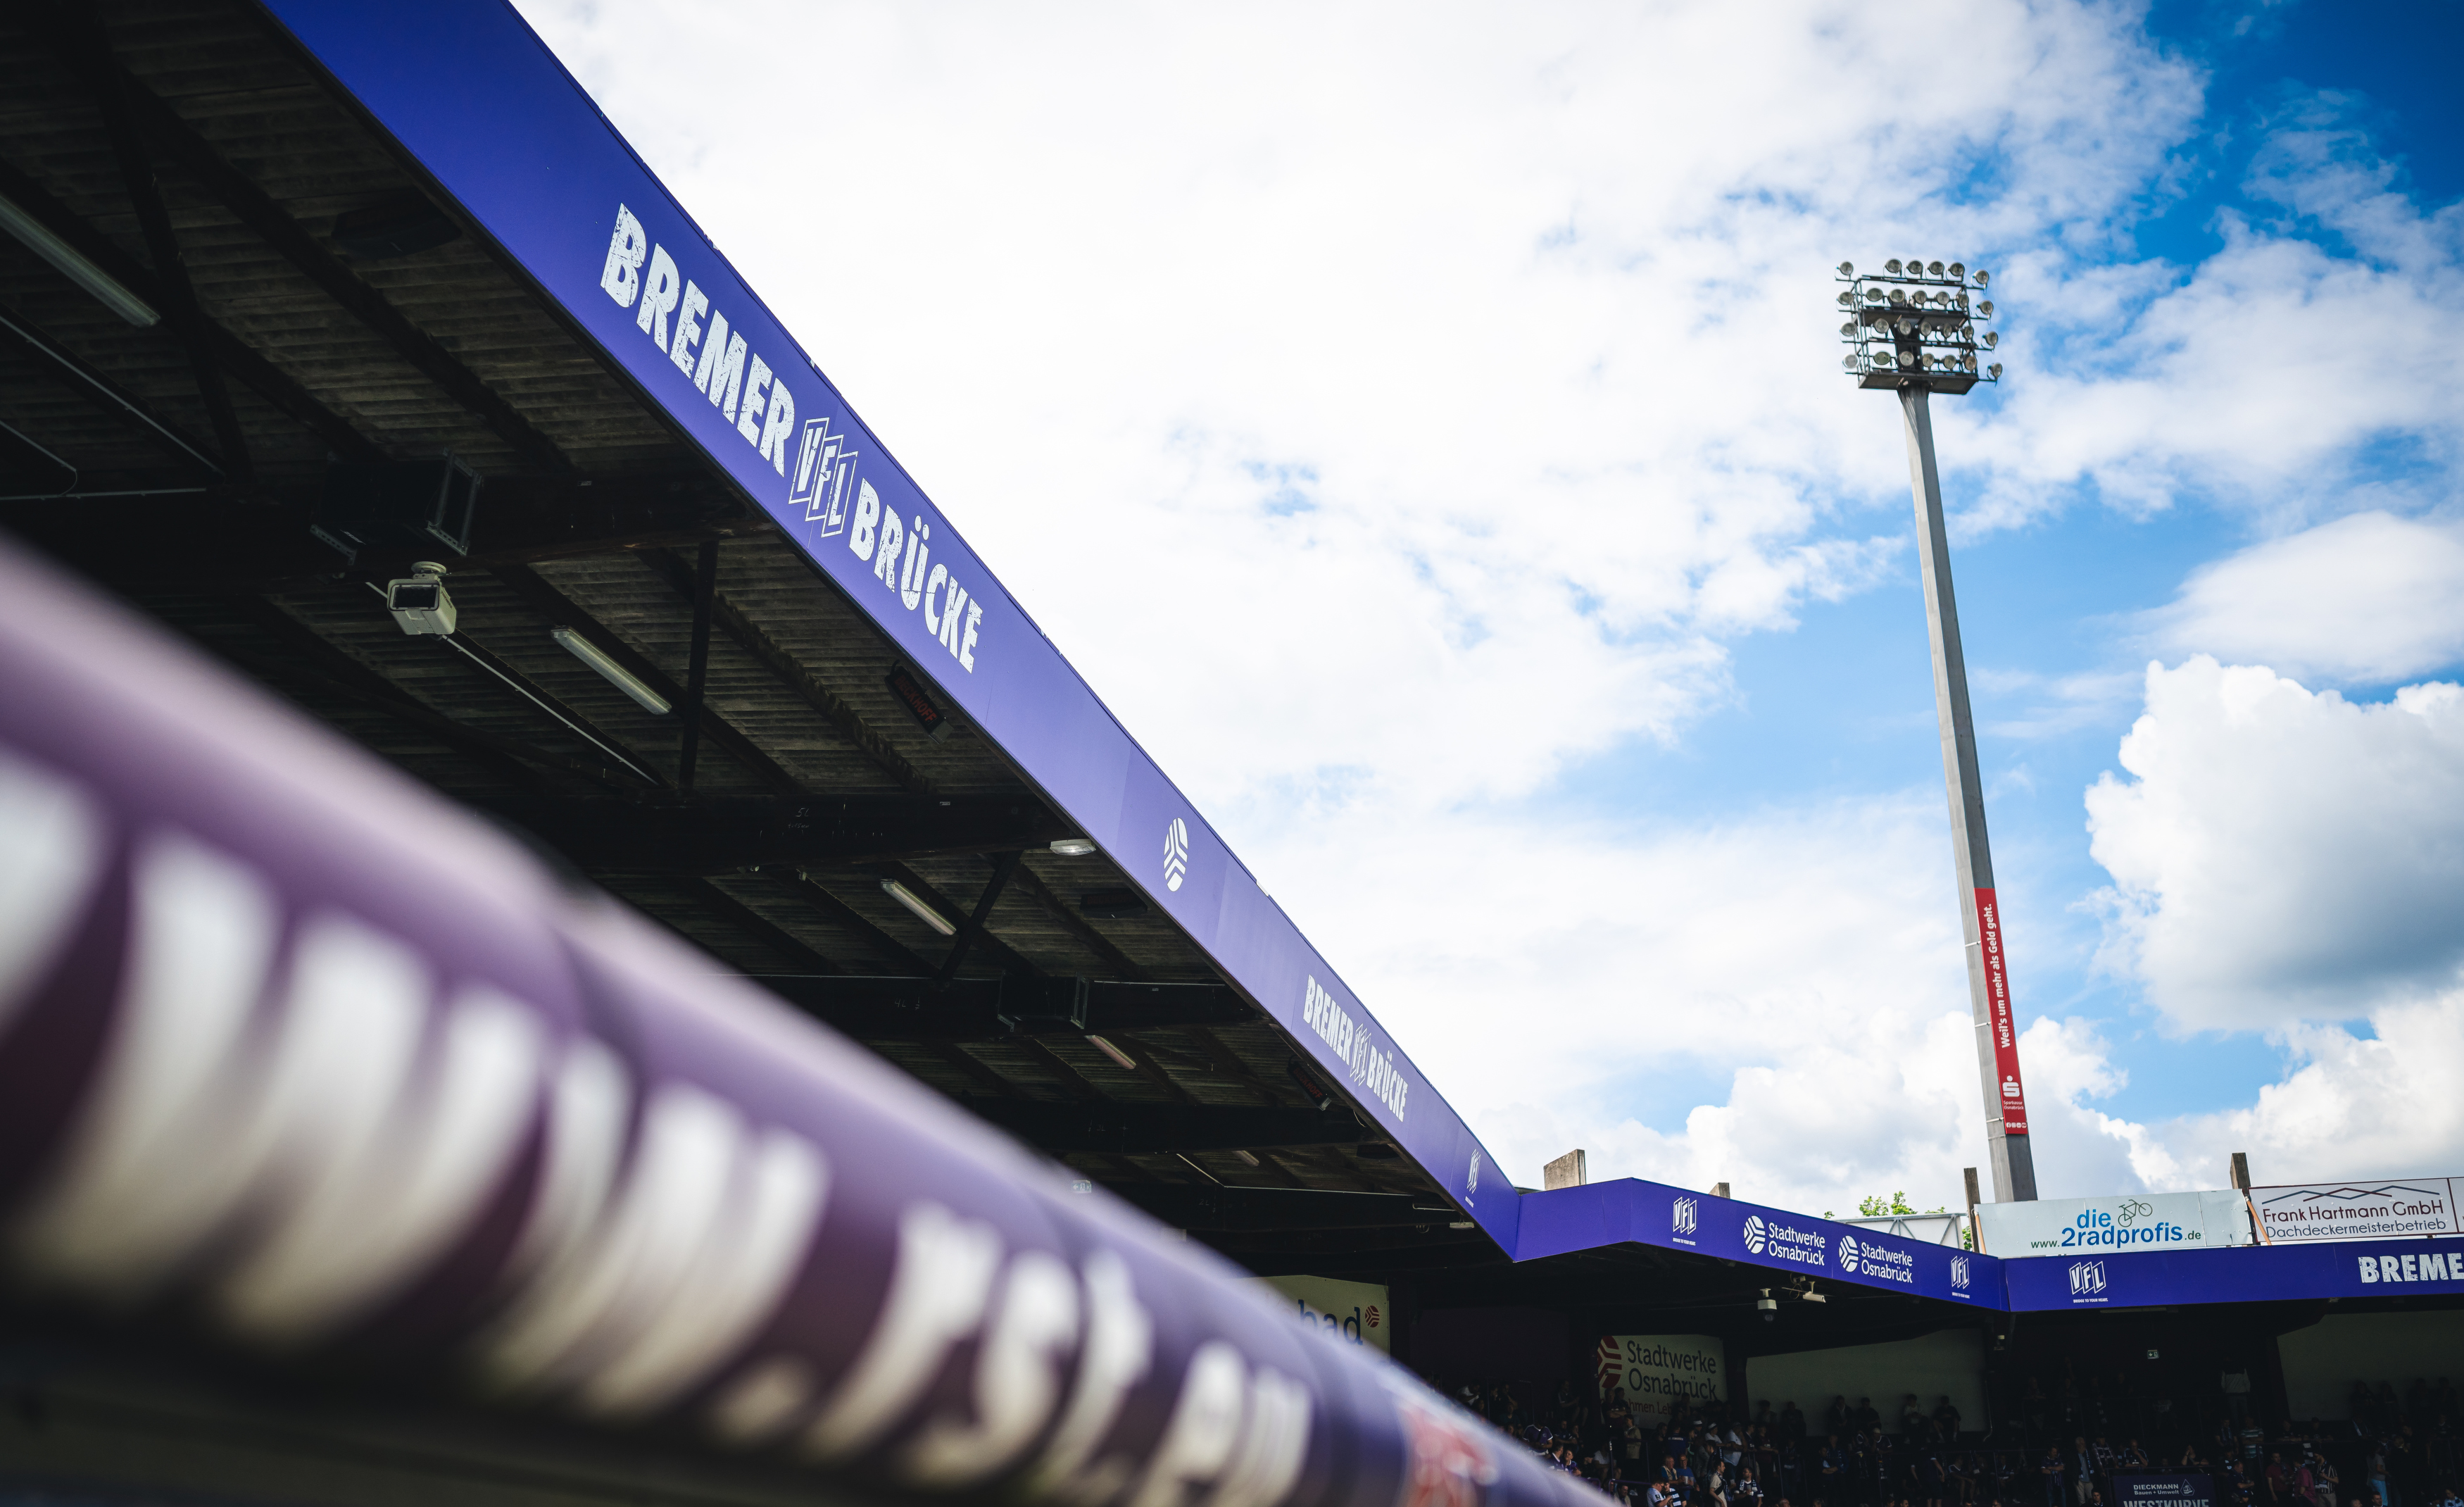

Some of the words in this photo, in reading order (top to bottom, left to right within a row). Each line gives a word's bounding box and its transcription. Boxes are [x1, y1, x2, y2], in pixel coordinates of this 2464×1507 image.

[601, 202, 796, 478] BREMER
[796, 425, 849, 529] VFL
[849, 477, 983, 674] BRÜCKE
[893, 674, 938, 722] BECKHOFF
[1983, 903, 1997, 929] geht.
[1986, 931, 1998, 953] Geld
[1990, 955, 2000, 970] als
[1992, 972, 2004, 998] mehr
[1997, 1000, 2006, 1015] um
[1998, 1018, 2010, 1049] Weil's
[1303, 974, 1354, 1065] BREMER
[1366, 1050, 1408, 1123] BRÜCKE
[1293, 1067, 1323, 1099] BECKHOFF
[1675, 1200, 1695, 1232] VFL
[2077, 1209, 2111, 1229] die
[2263, 1208, 2307, 1223] Frank
[2309, 1205, 2389, 1220] Hartmann
[2392, 1199, 2444, 1216] GmbH
[1768, 1222, 1825, 1249] Stadtwerke
[2265, 1218, 2446, 1238] Dachdeckermeisterbetrieb
[1768, 1240, 1825, 1266] Osnabrück
[1861, 1242, 1913, 1267] Stadtwerke
[1861, 1259, 1913, 1283] Osnabrück
[1951, 1258, 1968, 1286] VFL
[2070, 1265, 2104, 1291] VFL
[1298, 1299, 1364, 1345] bad
[1627, 1340, 1716, 1374] Stadtwerke
[1628, 1368, 1717, 1400] Osnabrück
[1628, 1398, 1654, 1413] hmen
[1657, 1401, 1673, 1415] Leb
